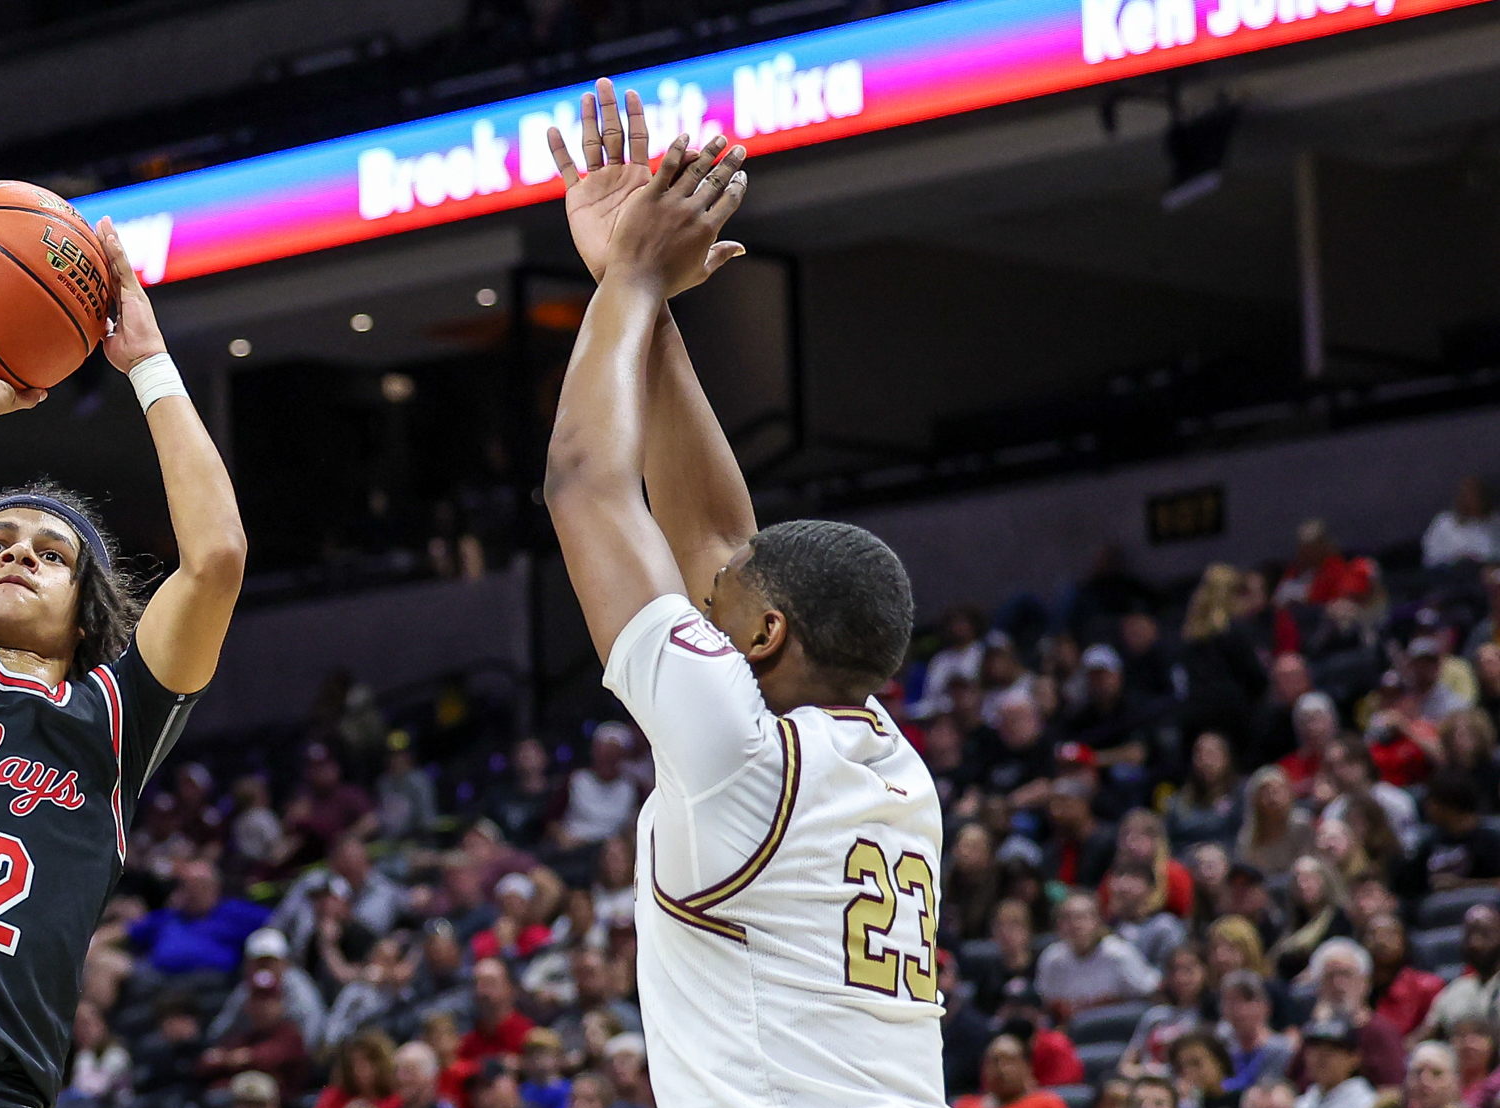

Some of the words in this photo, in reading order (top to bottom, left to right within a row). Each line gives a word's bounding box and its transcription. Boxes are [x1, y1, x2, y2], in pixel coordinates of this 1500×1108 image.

[1082, 0, 1197, 64] Ken
[358, 118, 510, 220] Brook
[733, 52, 863, 138] Nixa
[41, 225, 109, 306] LEGAC
[844, 837, 938, 1004] 23
